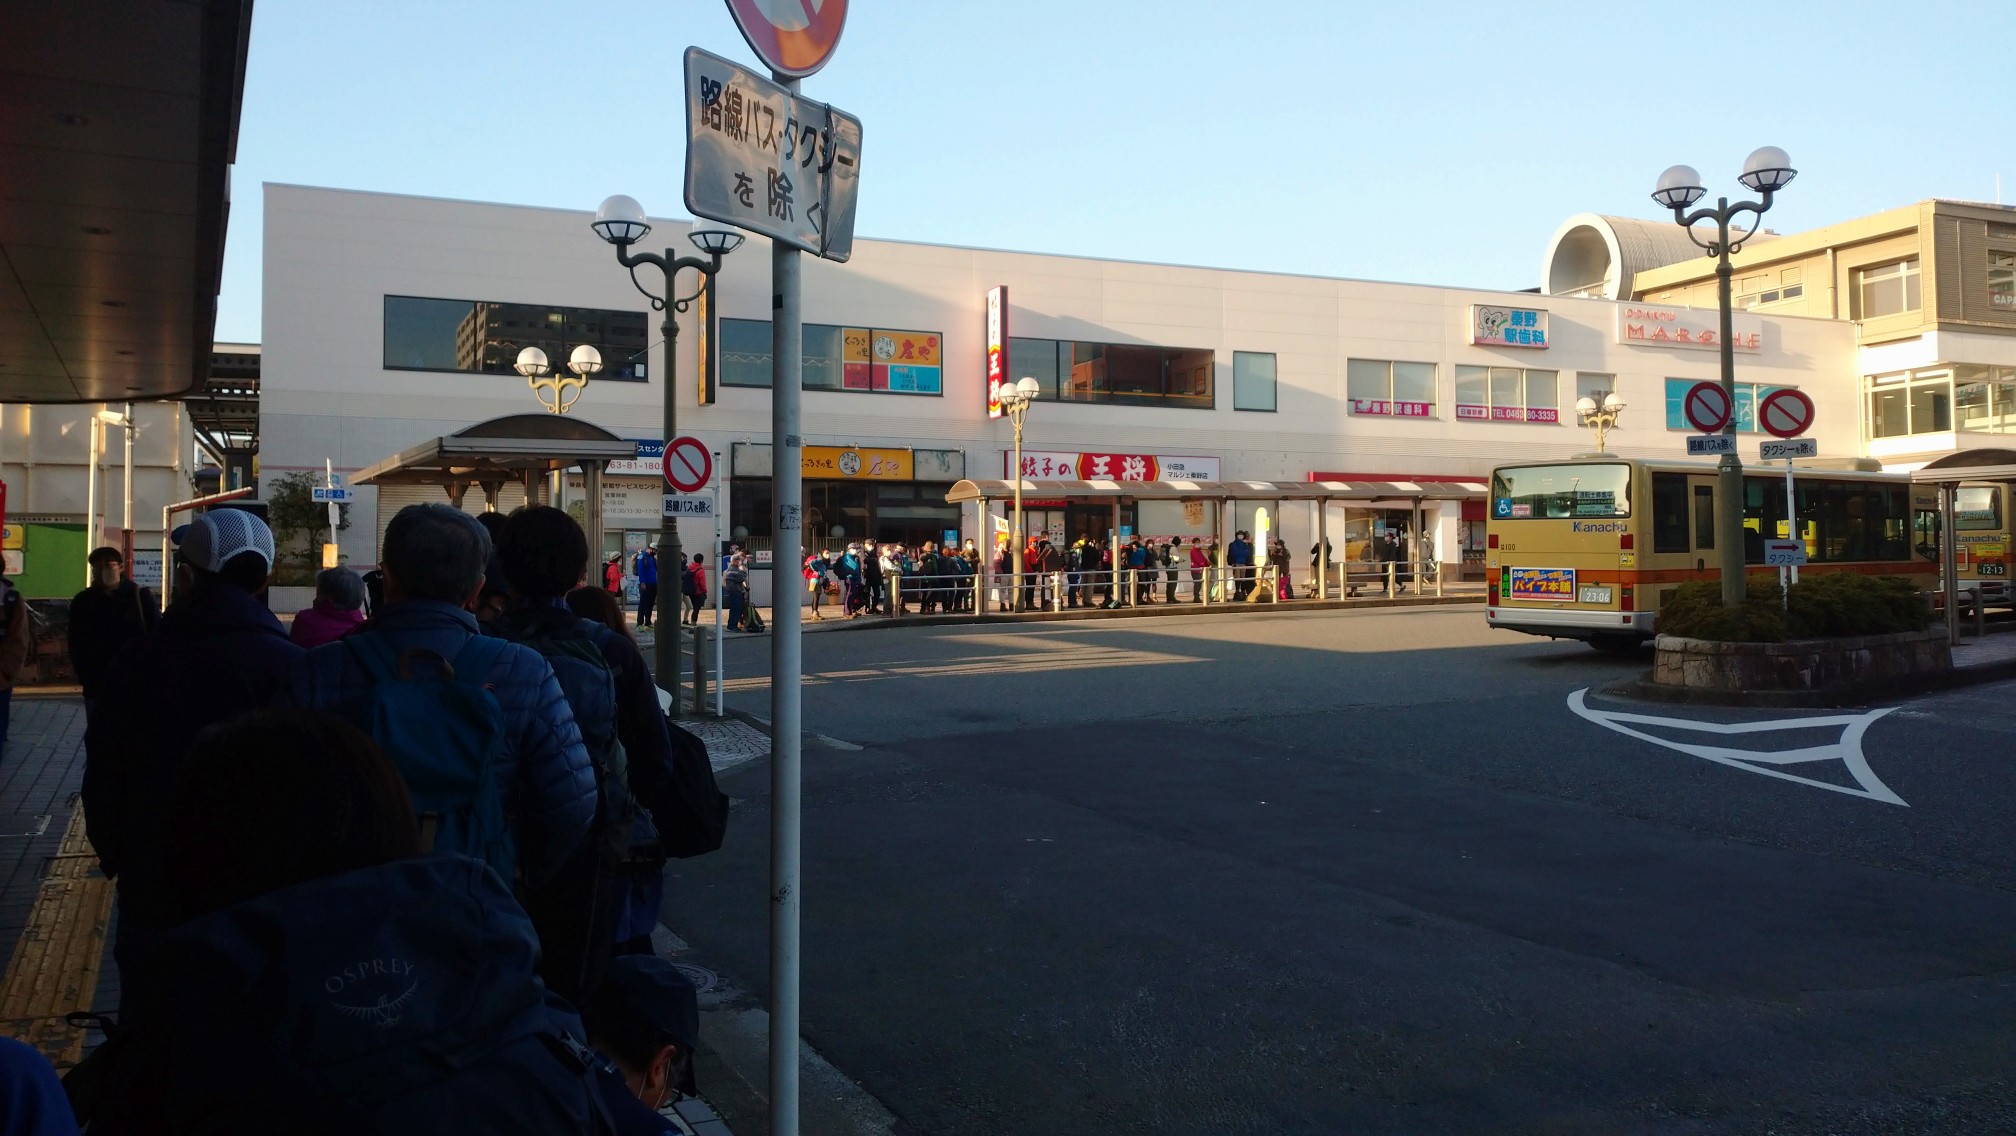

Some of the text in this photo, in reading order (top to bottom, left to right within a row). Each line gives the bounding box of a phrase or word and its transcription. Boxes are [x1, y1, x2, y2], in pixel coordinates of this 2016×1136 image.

[734, 166, 820, 235] を除く
[1511, 310, 1537, 328] 秦野
[1625, 308, 1677, 321] ODAKYU
[1504, 327, 1546, 346] 駅歯科
[1493, 408, 1505, 418] TEL
[1762, 442, 1815, 457] タクシーを除く
[1021, 455, 1147, 481] 餃子の 王将
[665, 499, 711, 514] 路線バスを除く
[1573, 521, 1628, 533] Kanachu
[1768, 553, 1803, 564] タクシー
[325, 958, 415, 993] OSPREY
